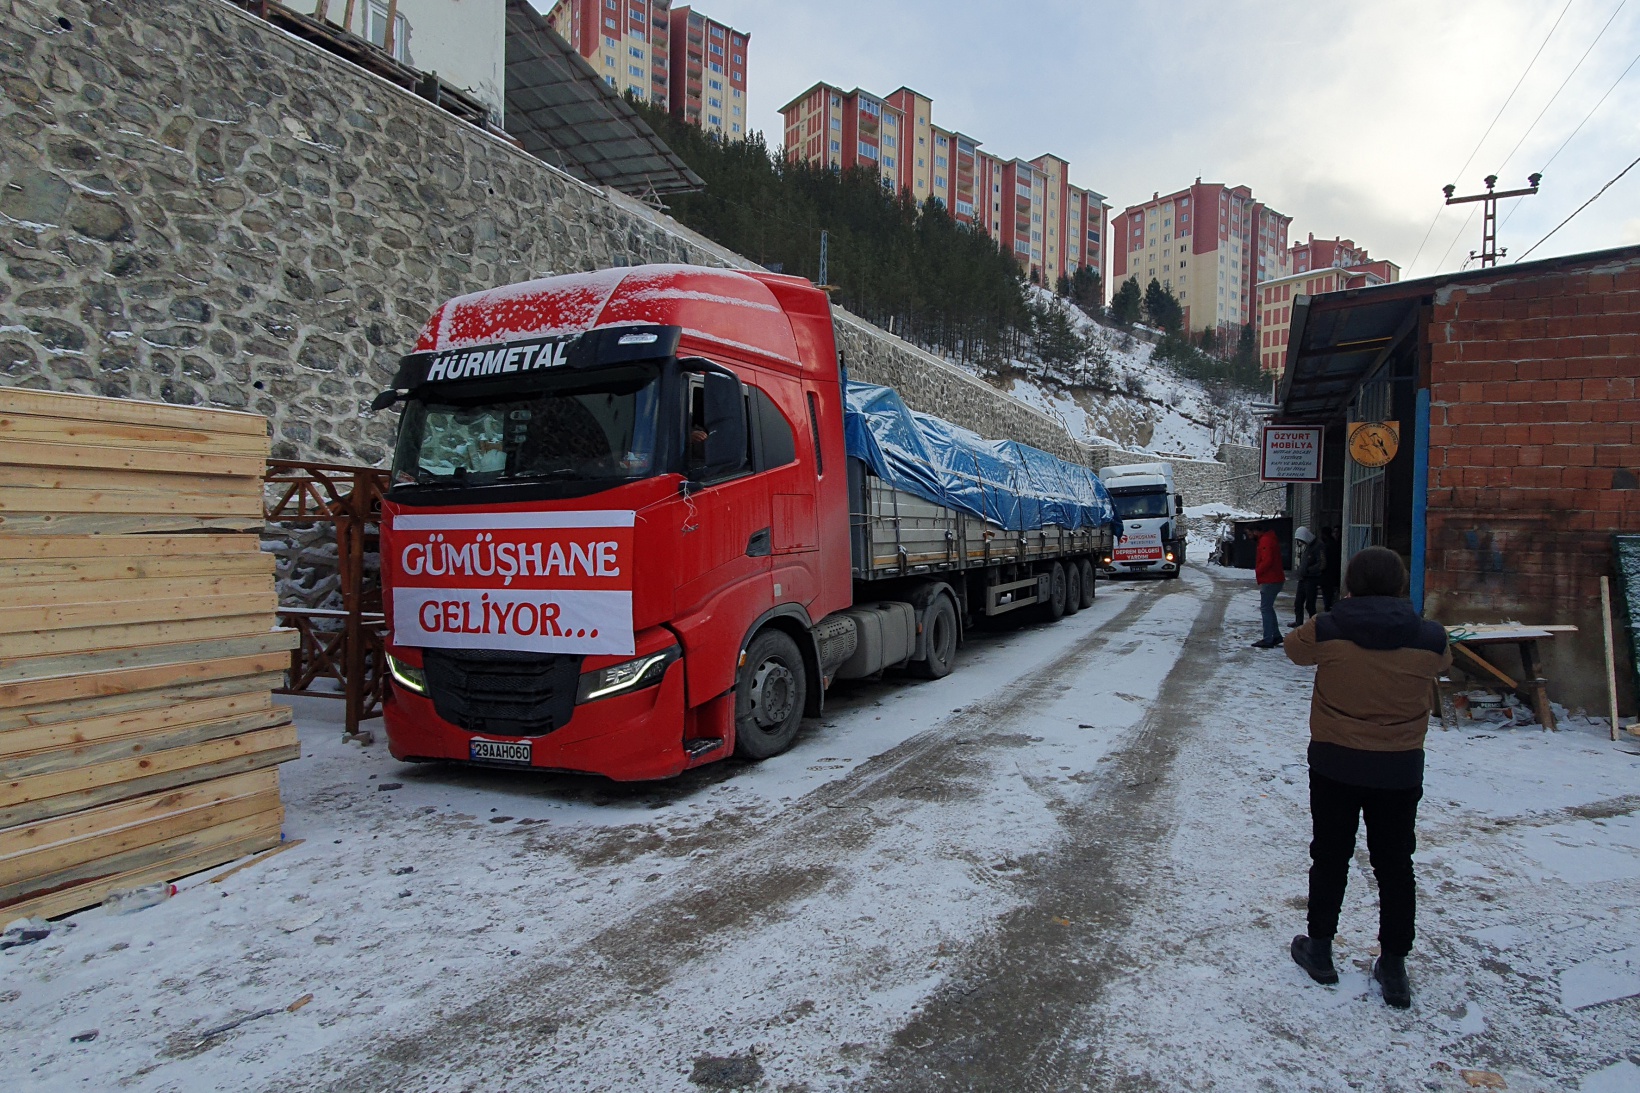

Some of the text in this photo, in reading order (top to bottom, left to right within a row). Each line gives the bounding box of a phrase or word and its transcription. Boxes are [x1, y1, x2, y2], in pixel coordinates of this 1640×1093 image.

[427, 342, 568, 382] HÜRMETAL
[1271, 441, 1313, 449] MOBİLYA
[1273, 432, 1311, 440] ÖZYURT
[401, 533, 620, 586] GÜMÜŞHANE
[418, 592, 599, 640] GELİYOR...
[475, 744, 530, 760] 29AAH060
